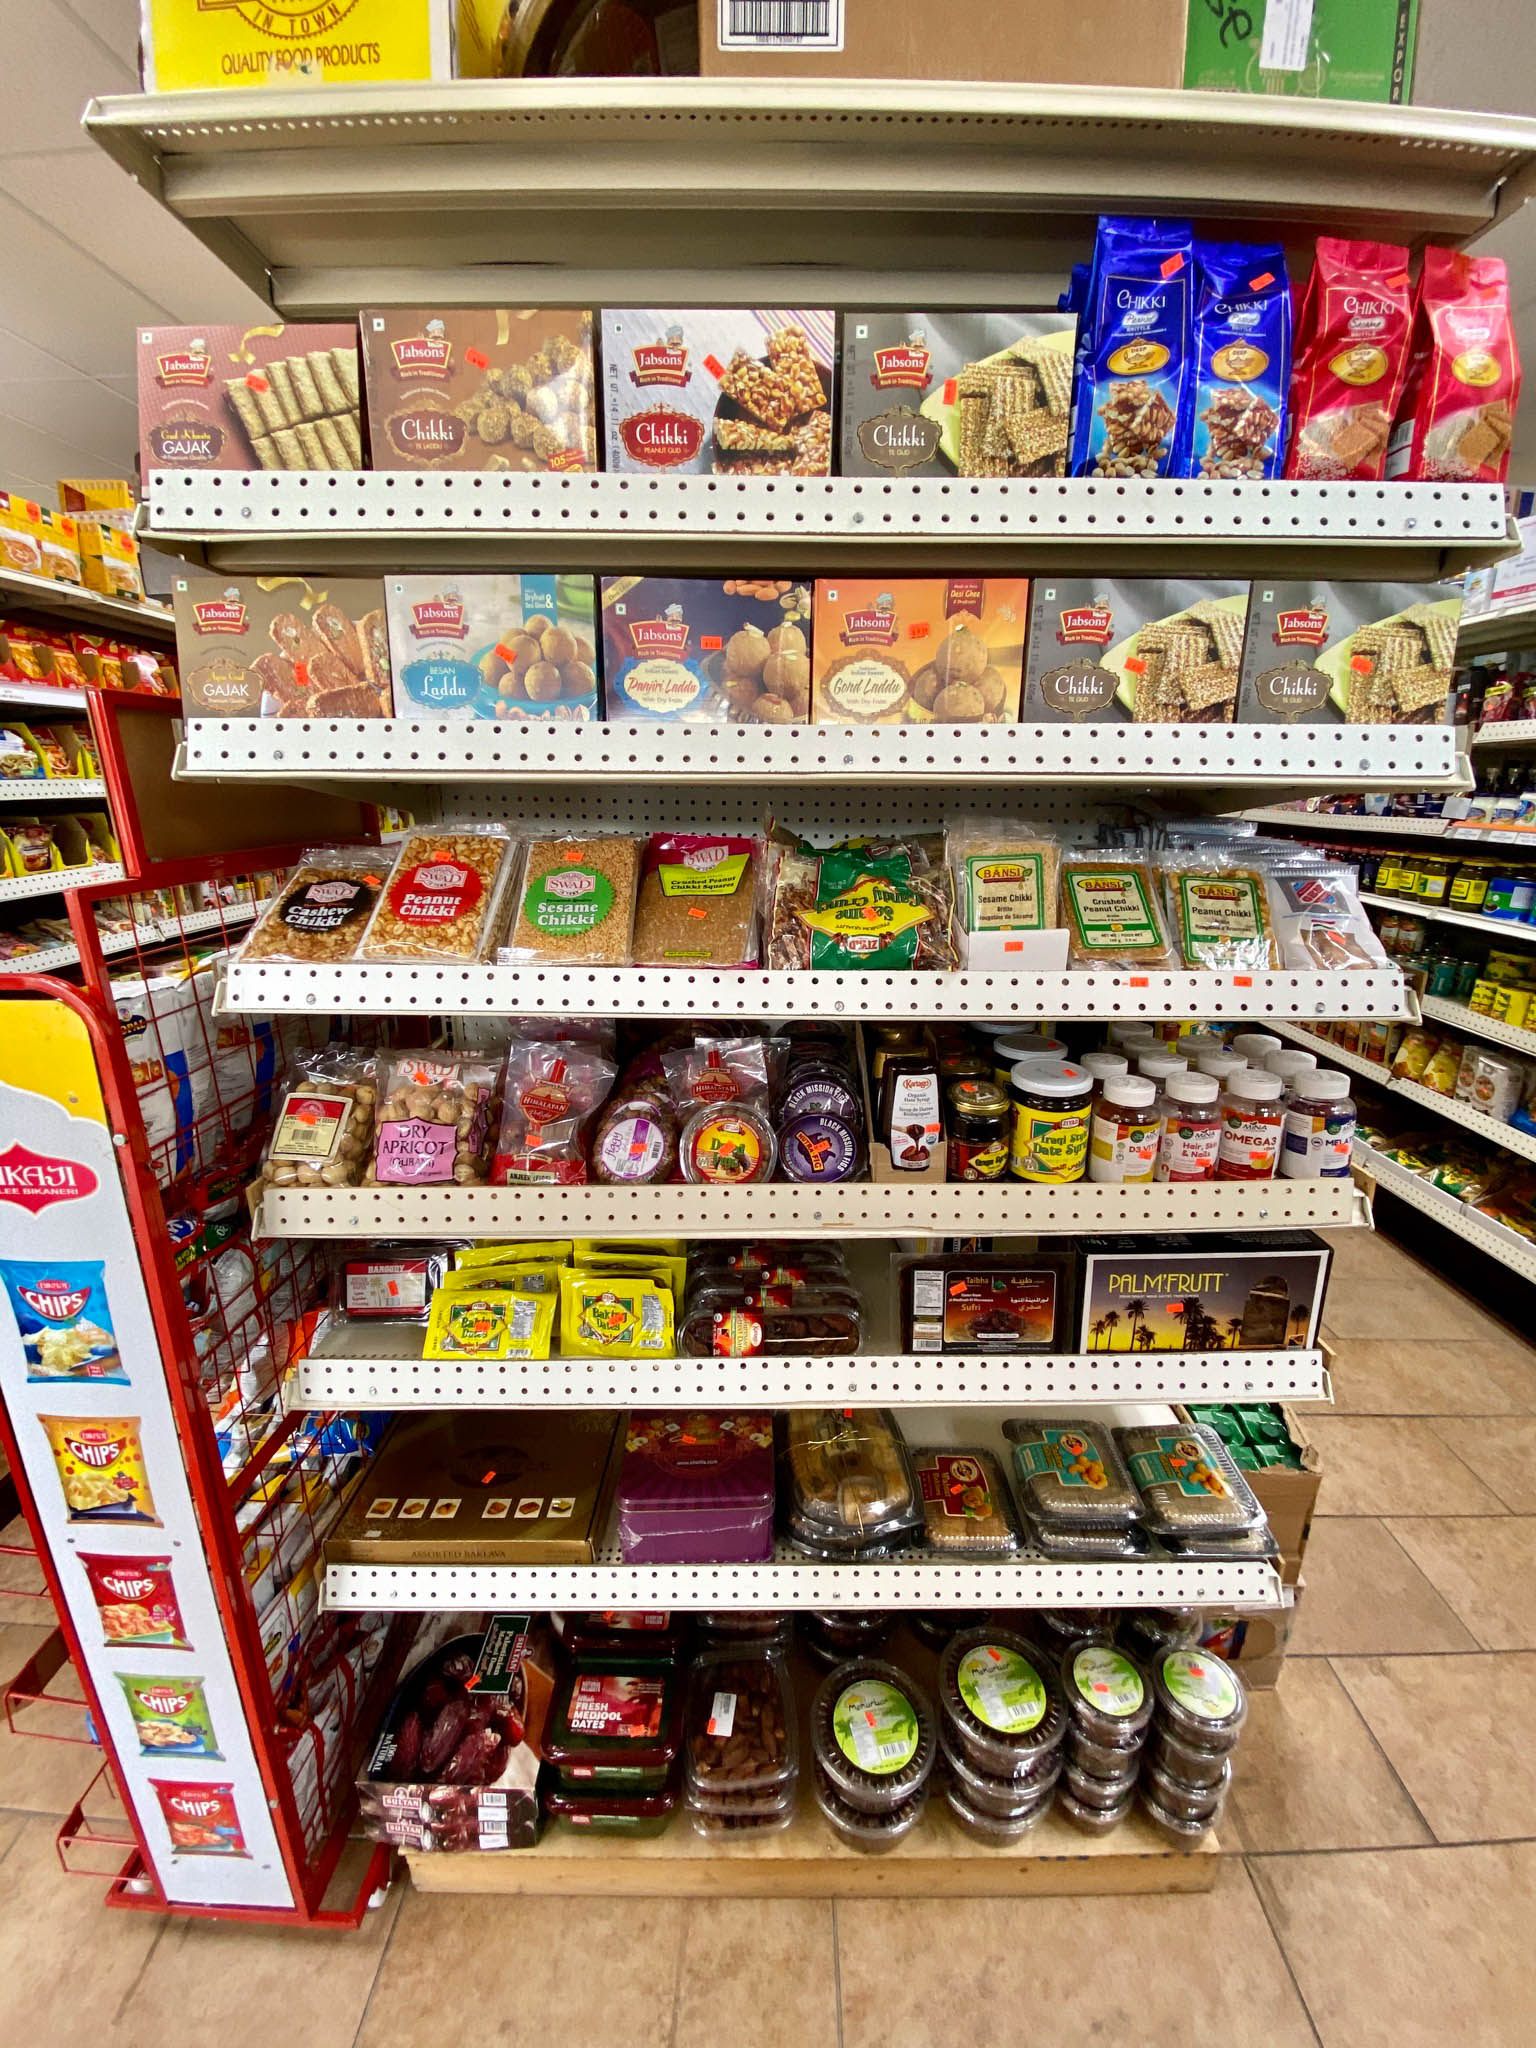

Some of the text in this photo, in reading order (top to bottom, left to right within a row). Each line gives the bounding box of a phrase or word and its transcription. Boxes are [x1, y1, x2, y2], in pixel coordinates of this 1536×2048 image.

[252, 3, 341, 33] IN TOWN
[221, 43, 381, 75] QUALITY FOOD PRODUCTS
[1116, 289, 1166, 309] CHIKKI
[1344, 296, 1395, 315] CHIKKI
[1214, 300, 1268, 315] CHIKKI
[400, 346, 445, 360] Jabsons
[640, 352, 683, 366] Jabsons
[164, 359, 205, 372] Jabsons
[880, 355, 925, 369] Jabsons
[401, 419, 454, 441] Chikki
[635, 423, 688, 445] Chikki
[873, 425, 926, 447] Chikki
[162, 440, 210, 455] GAJAK
[201, 608, 241, 620] Jabsons
[418, 607, 460, 619] Jabsons
[849, 616, 891, 629] Jabsons
[1066, 615, 1107, 628] Jabsons
[1282, 617, 1322, 629] Jabsons
[638, 628, 683, 642] Jabsons
[203, 683, 249, 697] GAJAK
[420, 675, 467, 700] Laddu
[627, 677, 697, 694] Panjiri Laddu
[834, 678, 900, 696] Gond Laddu
[1055, 675, 1104, 695] Chikki
[1269, 676, 1318, 696] Chikki
[687, 847, 726, 866] SWAD
[418, 871, 464, 884] SWAD
[983, 868, 1021, 878] BANSI
[312, 885, 355, 898] SWAD
[550, 880, 592, 889] SWAD
[1085, 881, 1123, 890] BANSI
[1198, 887, 1236, 896] BANSI
[403, 893, 462, 906] Peanut
[813, 886, 921, 914] Candy Crunch
[978, 893, 1033, 904] Sesame Chikki
[288, 905, 355, 917] Cashew
[400, 905, 457, 917] Chikki
[537, 902, 599, 914] Sesame
[834, 905, 895, 921] Seame
[1114, 904, 1140, 912] Chikki
[1191, 906, 1252, 918] Peanut Chikki
[284, 915, 344, 927] Chikki
[537, 914, 595, 926] Chikki
[696, 1084, 737, 1093] HIMALAYAN
[788, 1091, 806, 1109] BLACK
[806, 1083, 834, 1094] MISSION
[523, 1096, 566, 1112] HIMALAYAN
[400, 1124, 432, 1138] DRY
[382, 1139, 448, 1155] APRICOT
[819, 1117, 854, 1172] BLACK MISSION FIGS
[1041, 1135, 1067, 1146] Iraqi
[1033, 1142, 1062, 1156] Date
[810, 1155, 821, 1170] FIG
[22, 1187, 79, 1196] BIKANERI
[966, 1276, 989, 1284] Taibha
[26, 1291, 84, 1317] CHIPS
[961, 1303, 981, 1312] Sufri
[70, 1441, 120, 1466] CHIPS
[102, 1576, 154, 1598] CHIPS
[509, 1636, 525, 1671] SULTAN
[139, 1692, 188, 1714] CHIPS
[575, 1702, 609, 1711] FRESH
[573, 1710, 623, 1721] MEDJOOL
[571, 1720, 606, 1729] DATES
[372, 1733, 395, 1773] NATURAL
[170, 1797, 221, 1817] CHIPS
[386, 1798, 420, 1807] SULTAN
[389, 1825, 422, 1835] SULTAN
